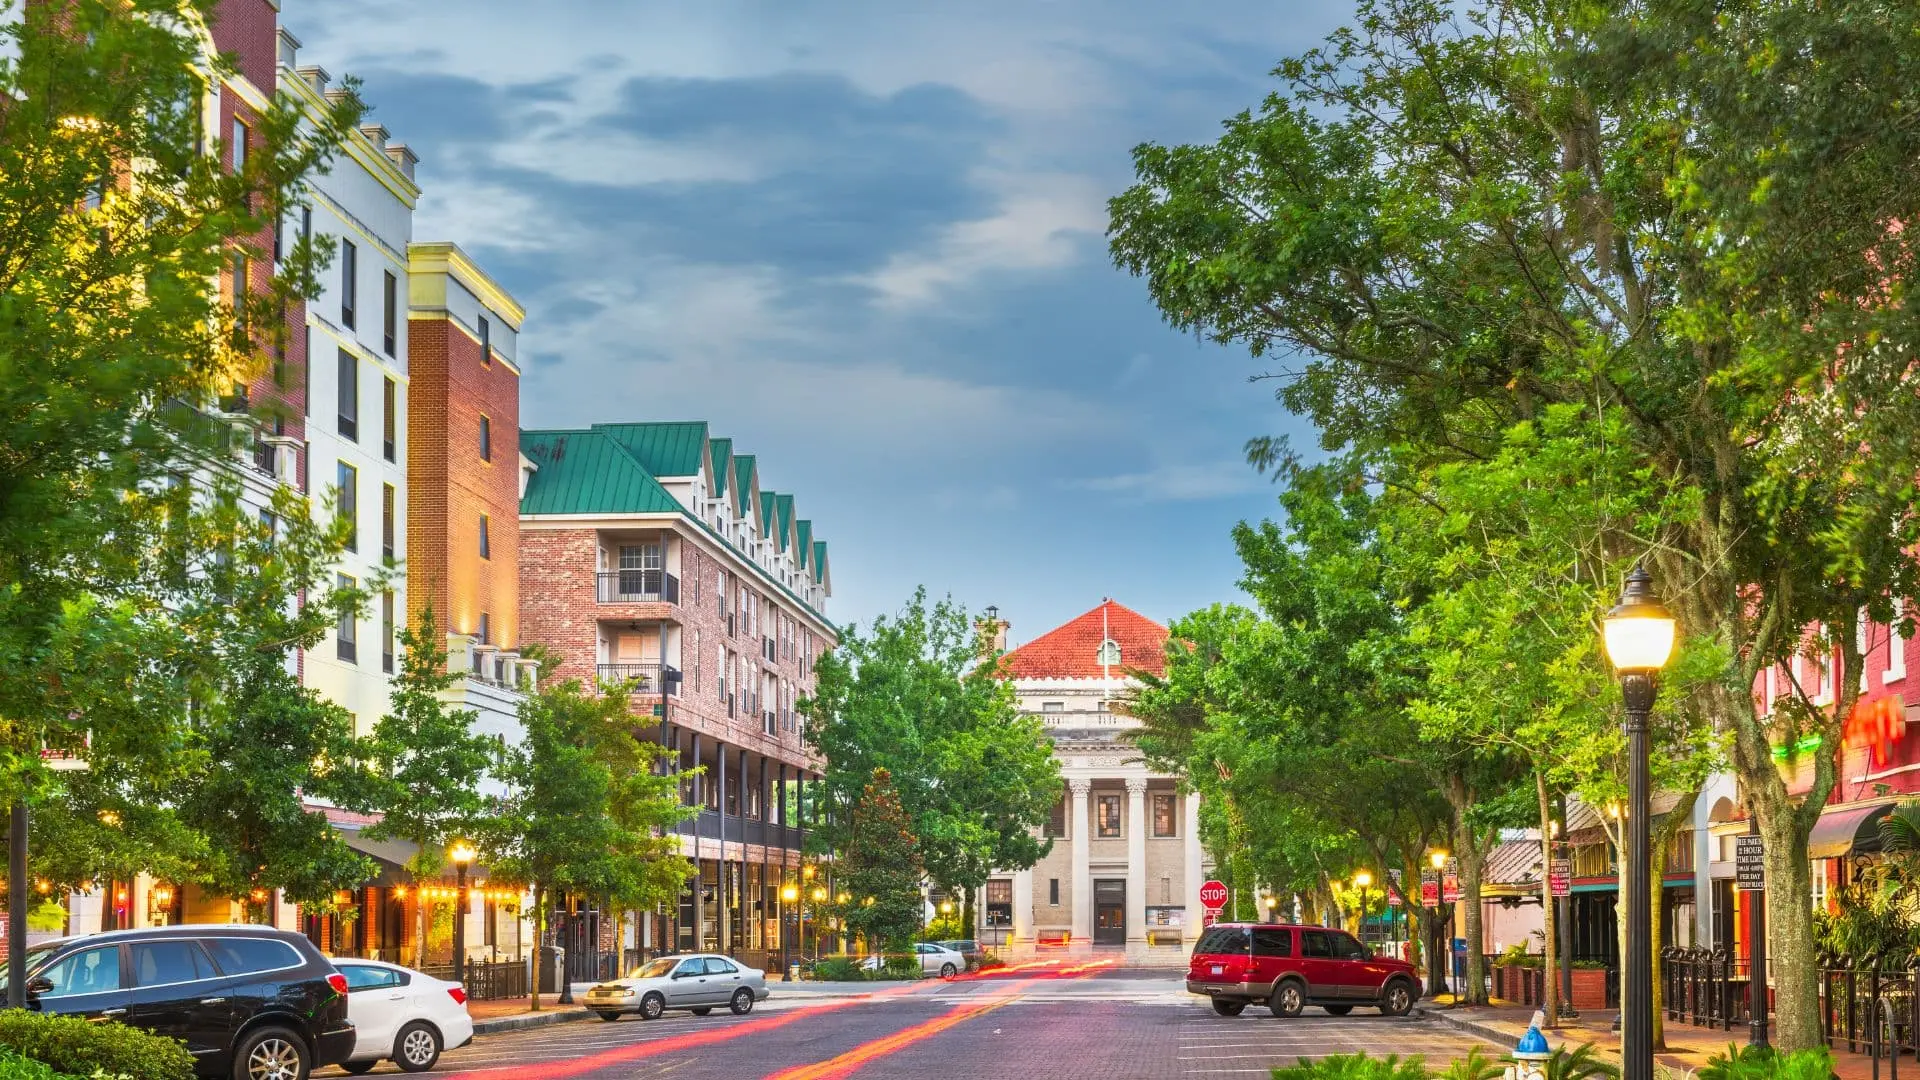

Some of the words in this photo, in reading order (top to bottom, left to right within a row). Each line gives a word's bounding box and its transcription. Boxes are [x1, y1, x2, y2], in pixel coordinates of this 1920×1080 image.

[1743, 846, 1762, 855] HOUR
[1737, 855, 1750, 864] TIME
[1750, 855, 1764, 864] LIMIT
[1201, 889, 1226, 900] STOP
